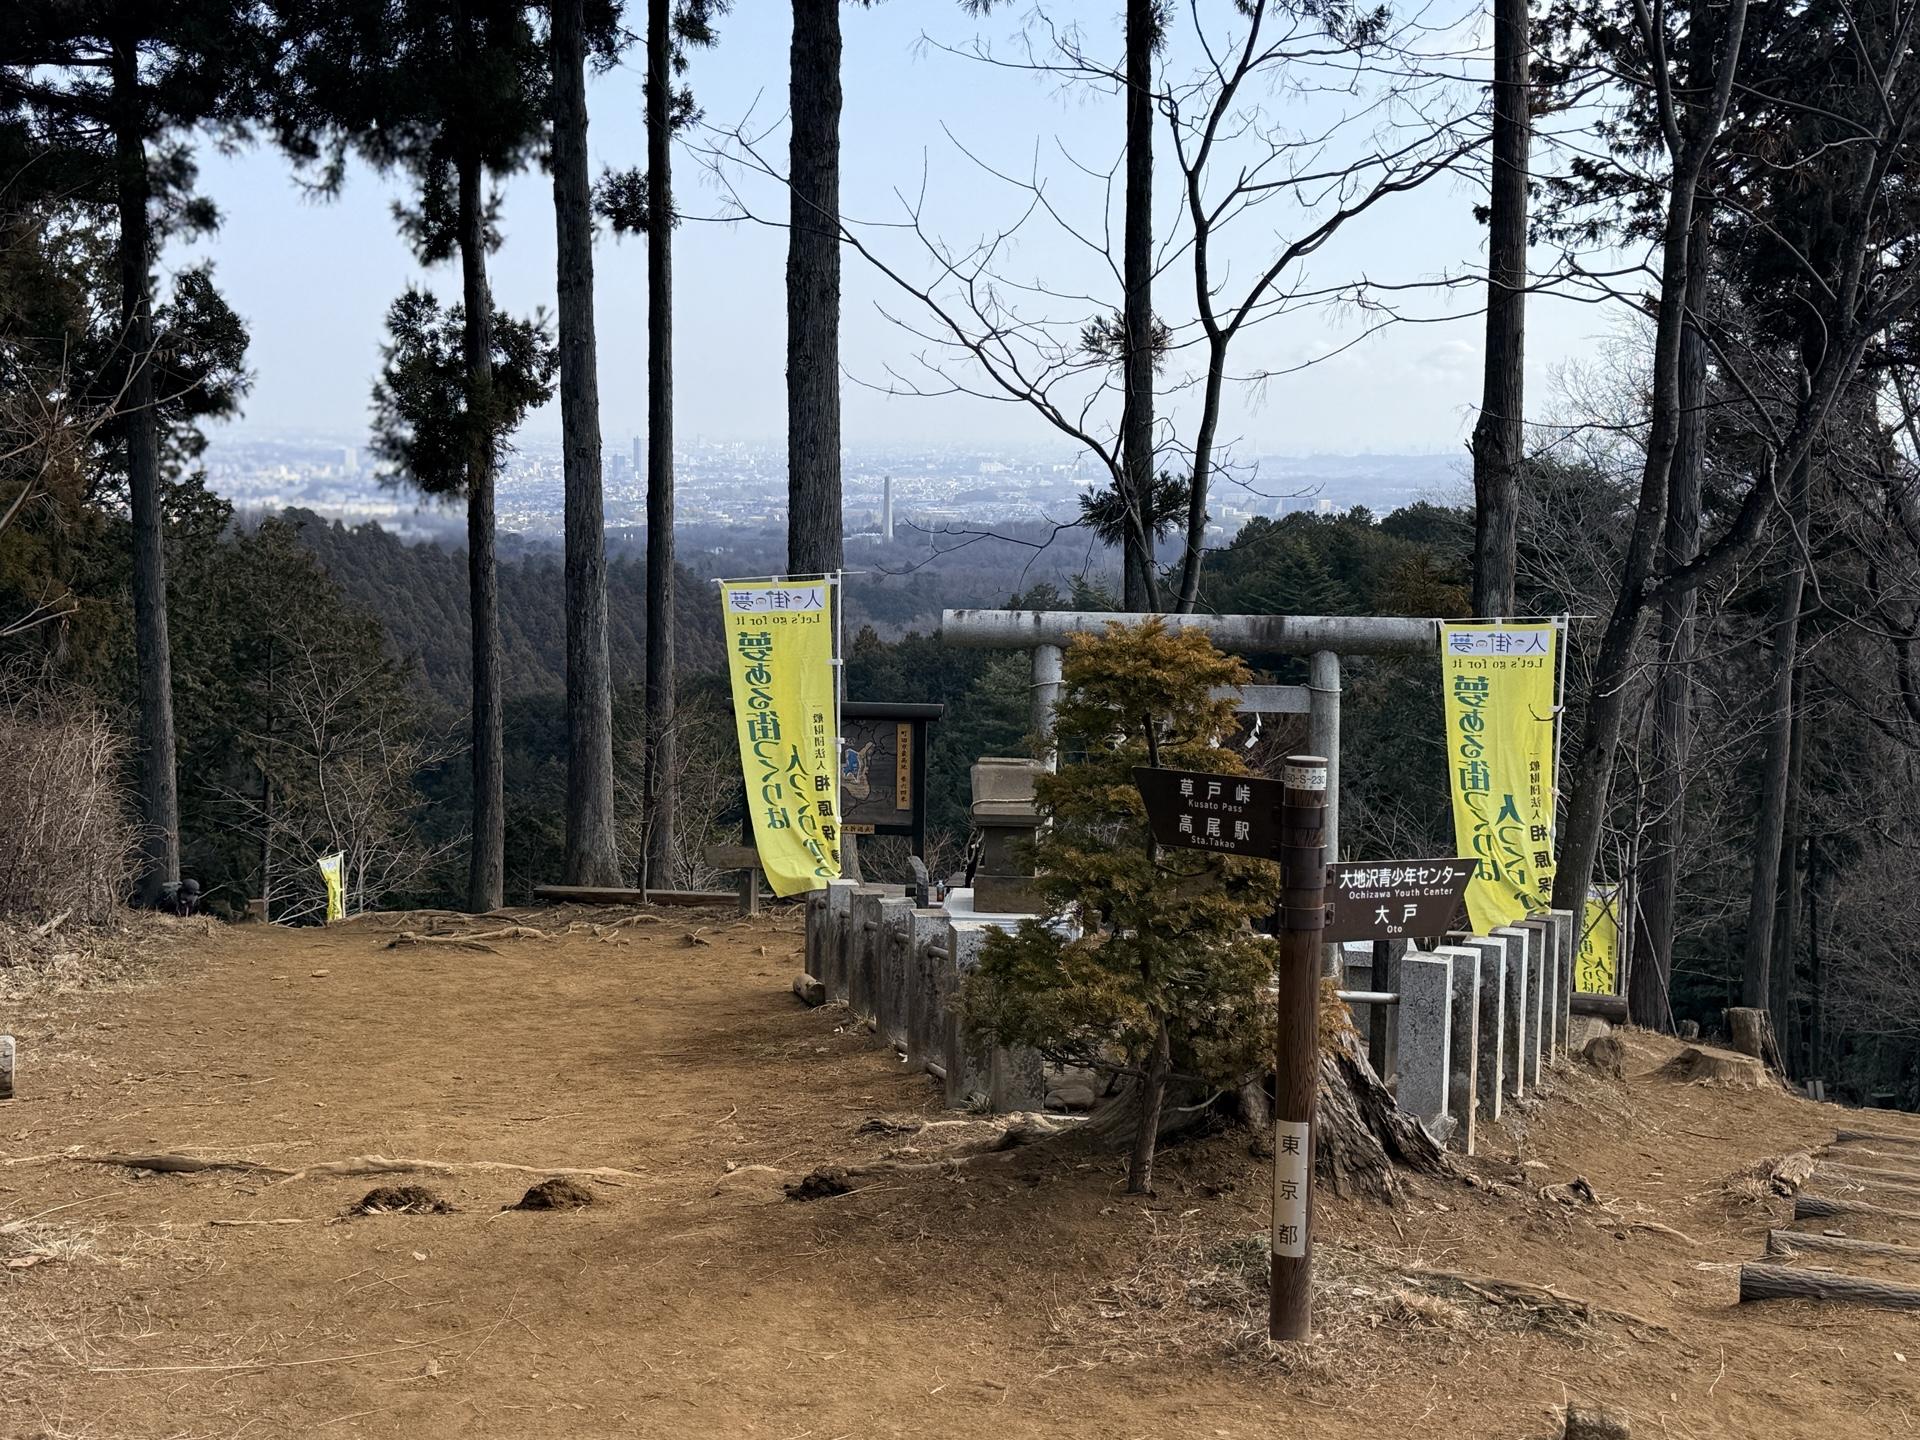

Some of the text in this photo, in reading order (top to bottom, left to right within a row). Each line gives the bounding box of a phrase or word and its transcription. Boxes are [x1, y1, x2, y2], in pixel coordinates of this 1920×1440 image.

[1180, 778, 1251, 804] 草戸峠
[1188, 799, 1243, 813] Kusato Pass
[1179, 814, 1250, 841] 高尾駅
[1339, 866, 1466, 889] 大地沢青少年センター
[1349, 887, 1454, 900] Ochizawa Youth Center
[1374, 904, 1418, 925] 大戸
[1386, 924, 1403, 934] Oto
[1278, 1135, 1301, 1246] 東京都
